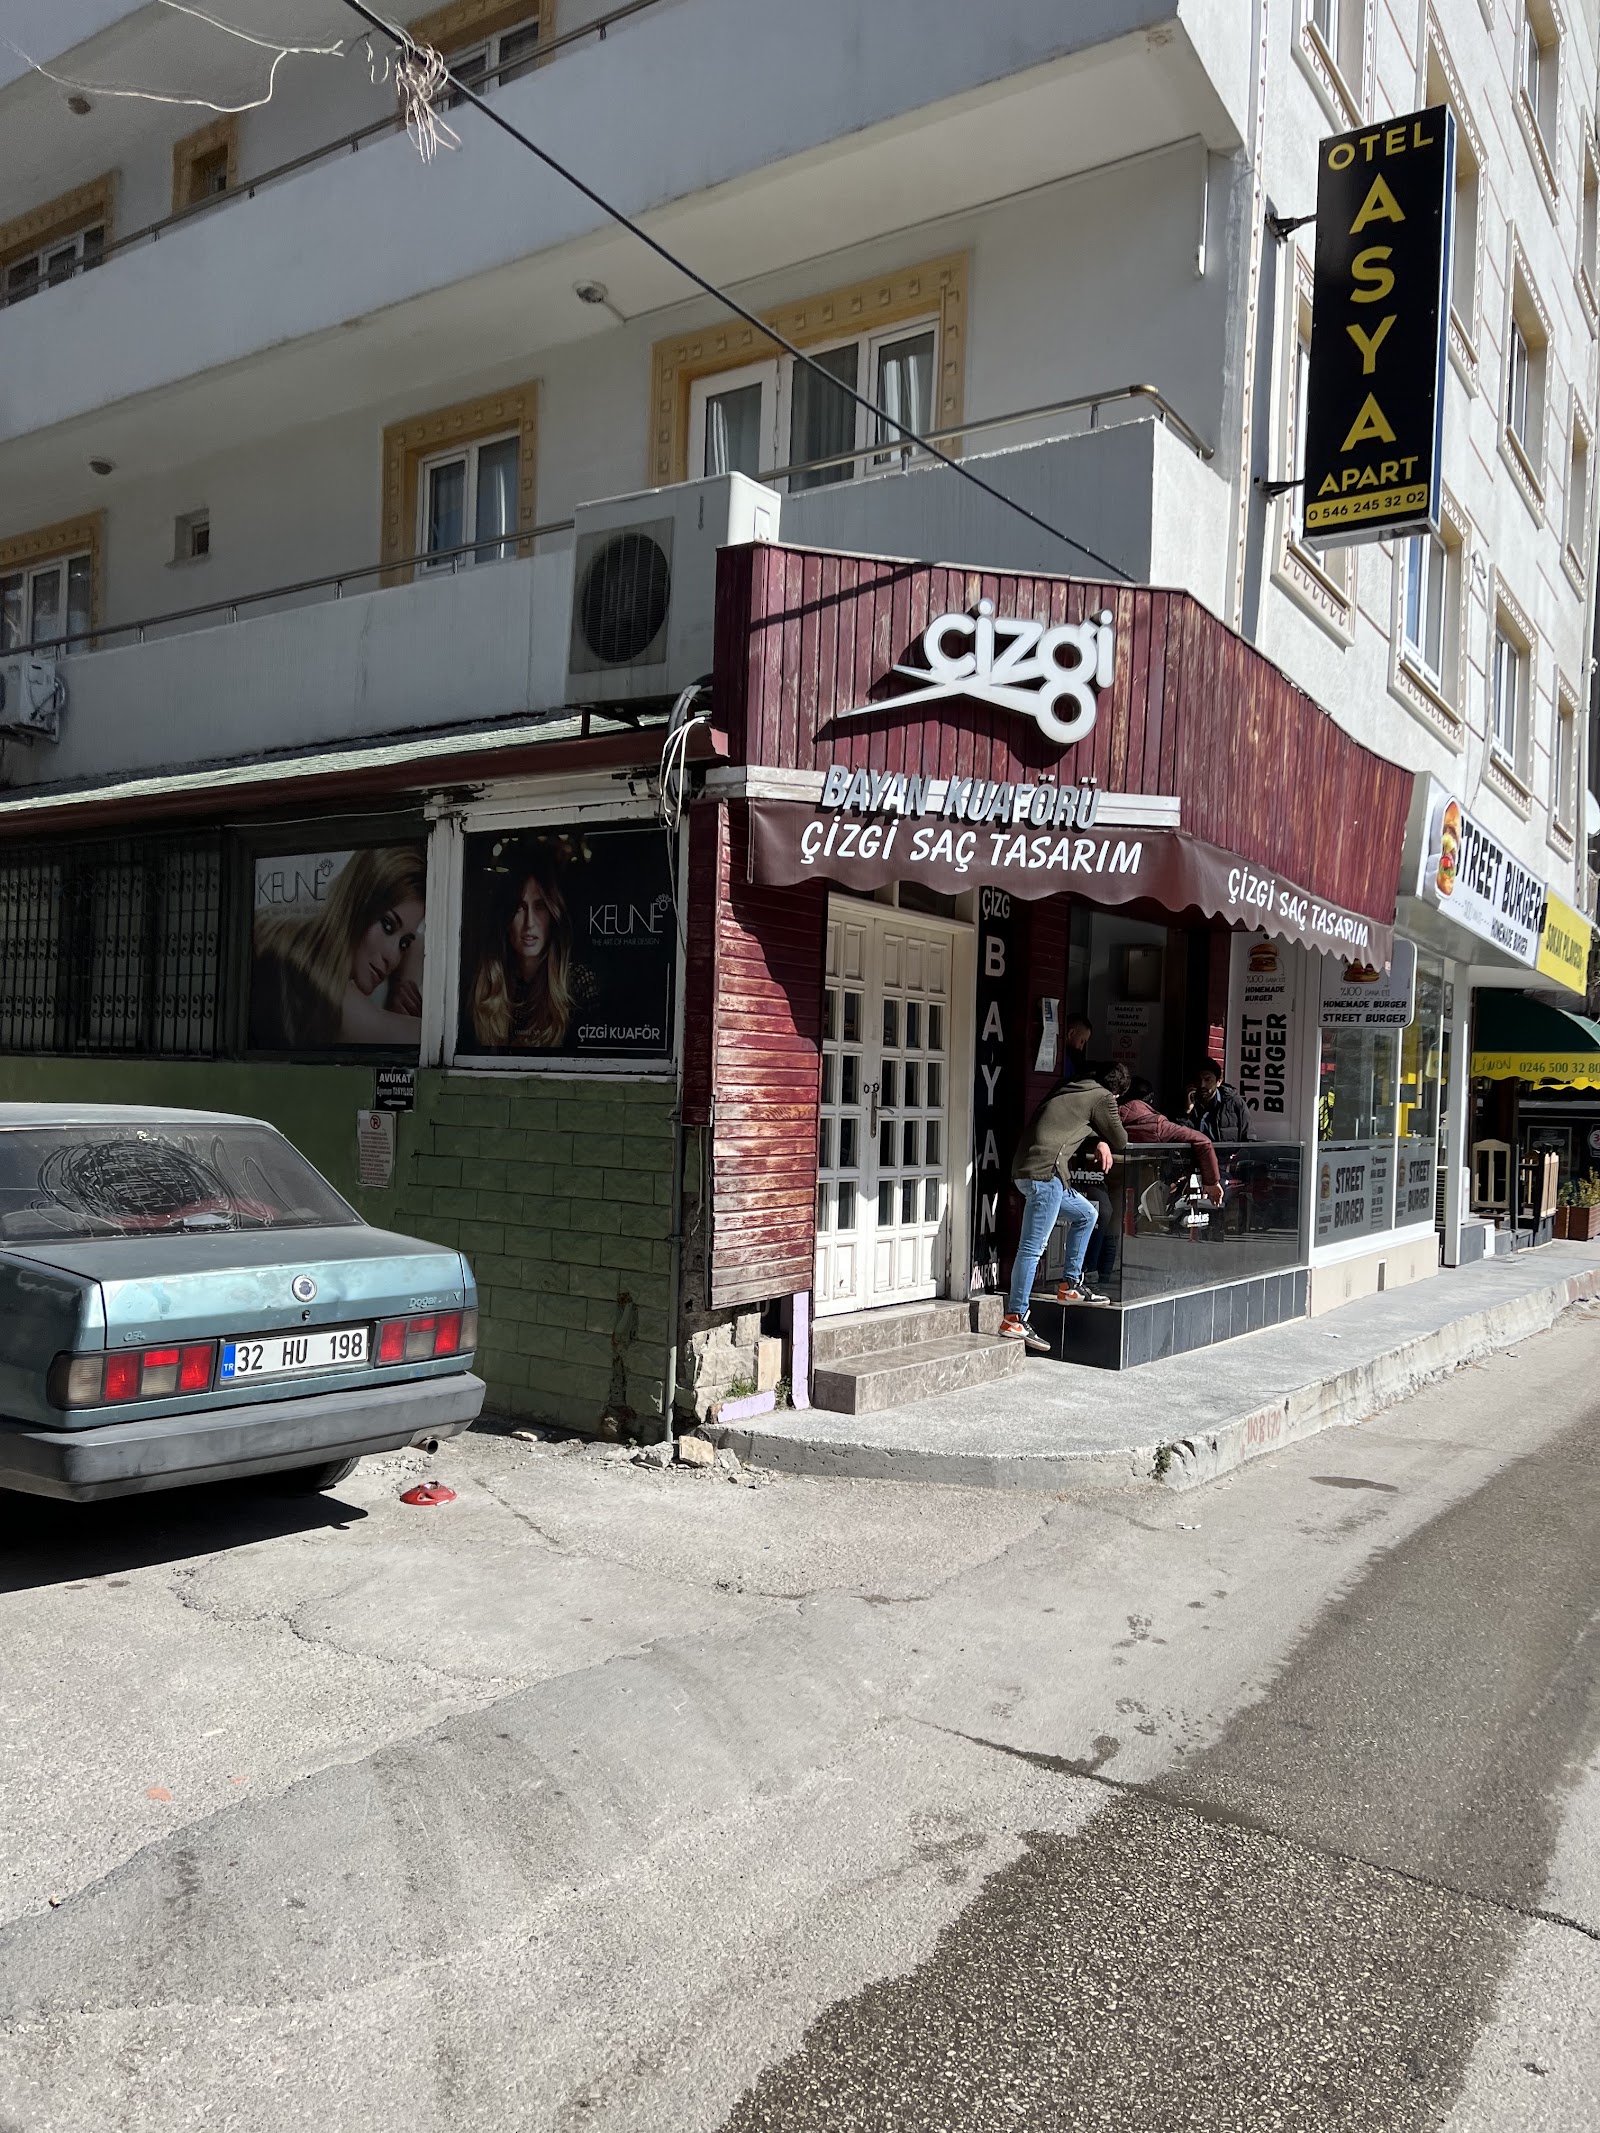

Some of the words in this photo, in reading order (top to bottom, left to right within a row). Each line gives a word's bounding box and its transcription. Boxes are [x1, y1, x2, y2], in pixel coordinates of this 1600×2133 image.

[1328, 121, 1434, 171] OTEL
[1339, 172, 1406, 453] ASYA
[1317, 455, 1419, 497] APART
[1308, 509, 1319, 521] 0
[1322, 502, 1349, 518] 546
[1353, 498, 1380, 514] 245
[1383, 495, 1402, 509] 32
[1406, 491, 1425, 506] 02
[822, 764, 930, 819] BAYAN
[942, 773, 1102, 830] KUAFÖRÜ
[800, 815, 900, 865] ÇİZGİ
[909, 825, 978, 873] SAÇ
[988, 832, 1143, 875] TASARIM
[257, 869, 326, 905] KEUNE
[1502, 861, 1542, 932] BURGER
[589, 902, 664, 935] KEUNE
[1228, 866, 1275, 912] ÇİZGİ
[1279, 891, 1308, 932] SAÇ
[1311, 904, 1369, 948] TASARIM
[1323, 1000, 1370, 1008] HOMEMADE
[1340, 987, 1362, 996] %100
[577, 1023, 608, 1042] ÇİZGİ
[609, 1024, 660, 1040] KUAFÖR
[1322, 1013, 1362, 1022] STREET
[1365, 1014, 1406, 1022] BURGER
[379, 1073, 411, 1083] AVUKAT
[1239, 1014, 1263, 1112] STREET
[1263, 1013, 1287, 1113] BURGER
[1519, 1062, 1545, 1073] 0246
[1549, 1062, 1568, 1073] 500
[1572, 1062, 1585, 1073] 32
[980, 936, 1005, 1235] BAYAN
[1336, 1165, 1365, 1194] STREET
[1409, 1160, 1430, 1183] STREET
[1334, 1197, 1364, 1229] BURGER
[223, 1362, 234, 1371] TR
[237, 1345, 263, 1372] 32
[282, 1339, 308, 1366] HU
[330, 1333, 363, 1360] 198
